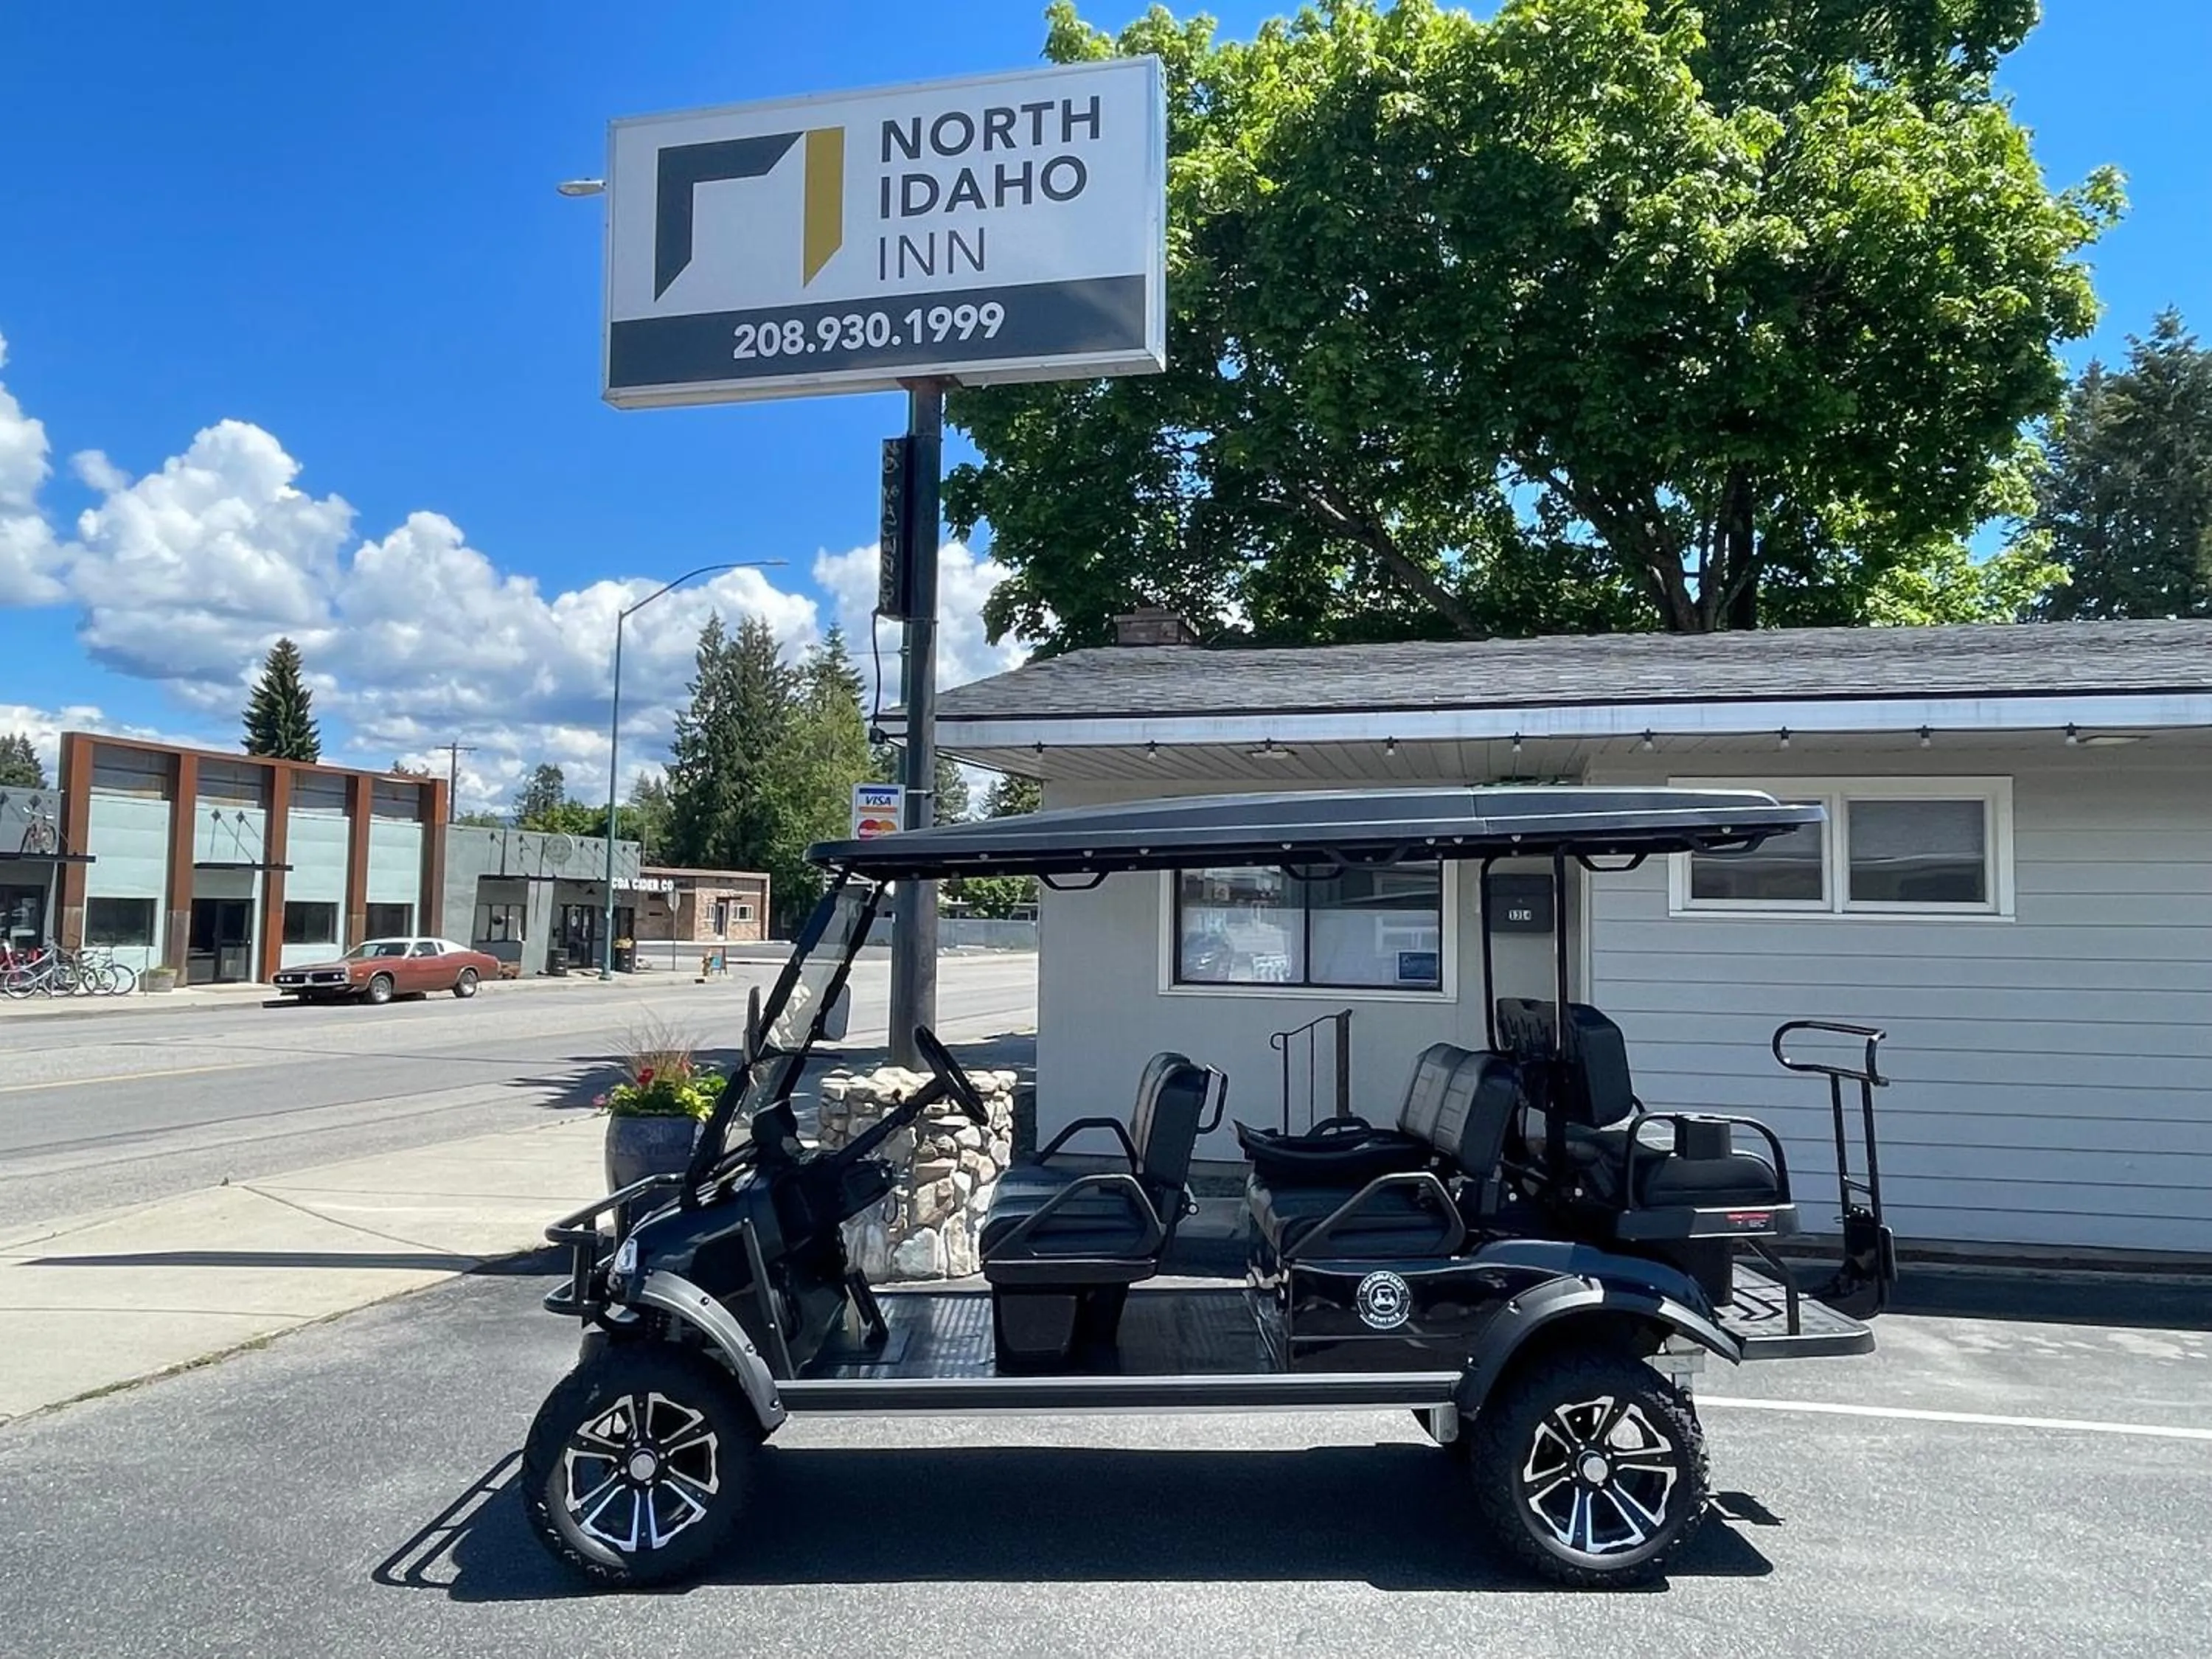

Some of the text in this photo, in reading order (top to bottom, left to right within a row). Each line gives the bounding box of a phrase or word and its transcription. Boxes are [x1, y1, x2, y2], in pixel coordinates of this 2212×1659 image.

[881, 95, 1101, 163] NORTH
[880, 155, 1088, 220] IDAHO
[878, 226, 986, 281] INN
[732, 301, 1006, 360] 208.930.1999
[866, 796, 891, 805] VISA
[632, 878, 659, 891] CIDER
[661, 880, 674, 891] CO
